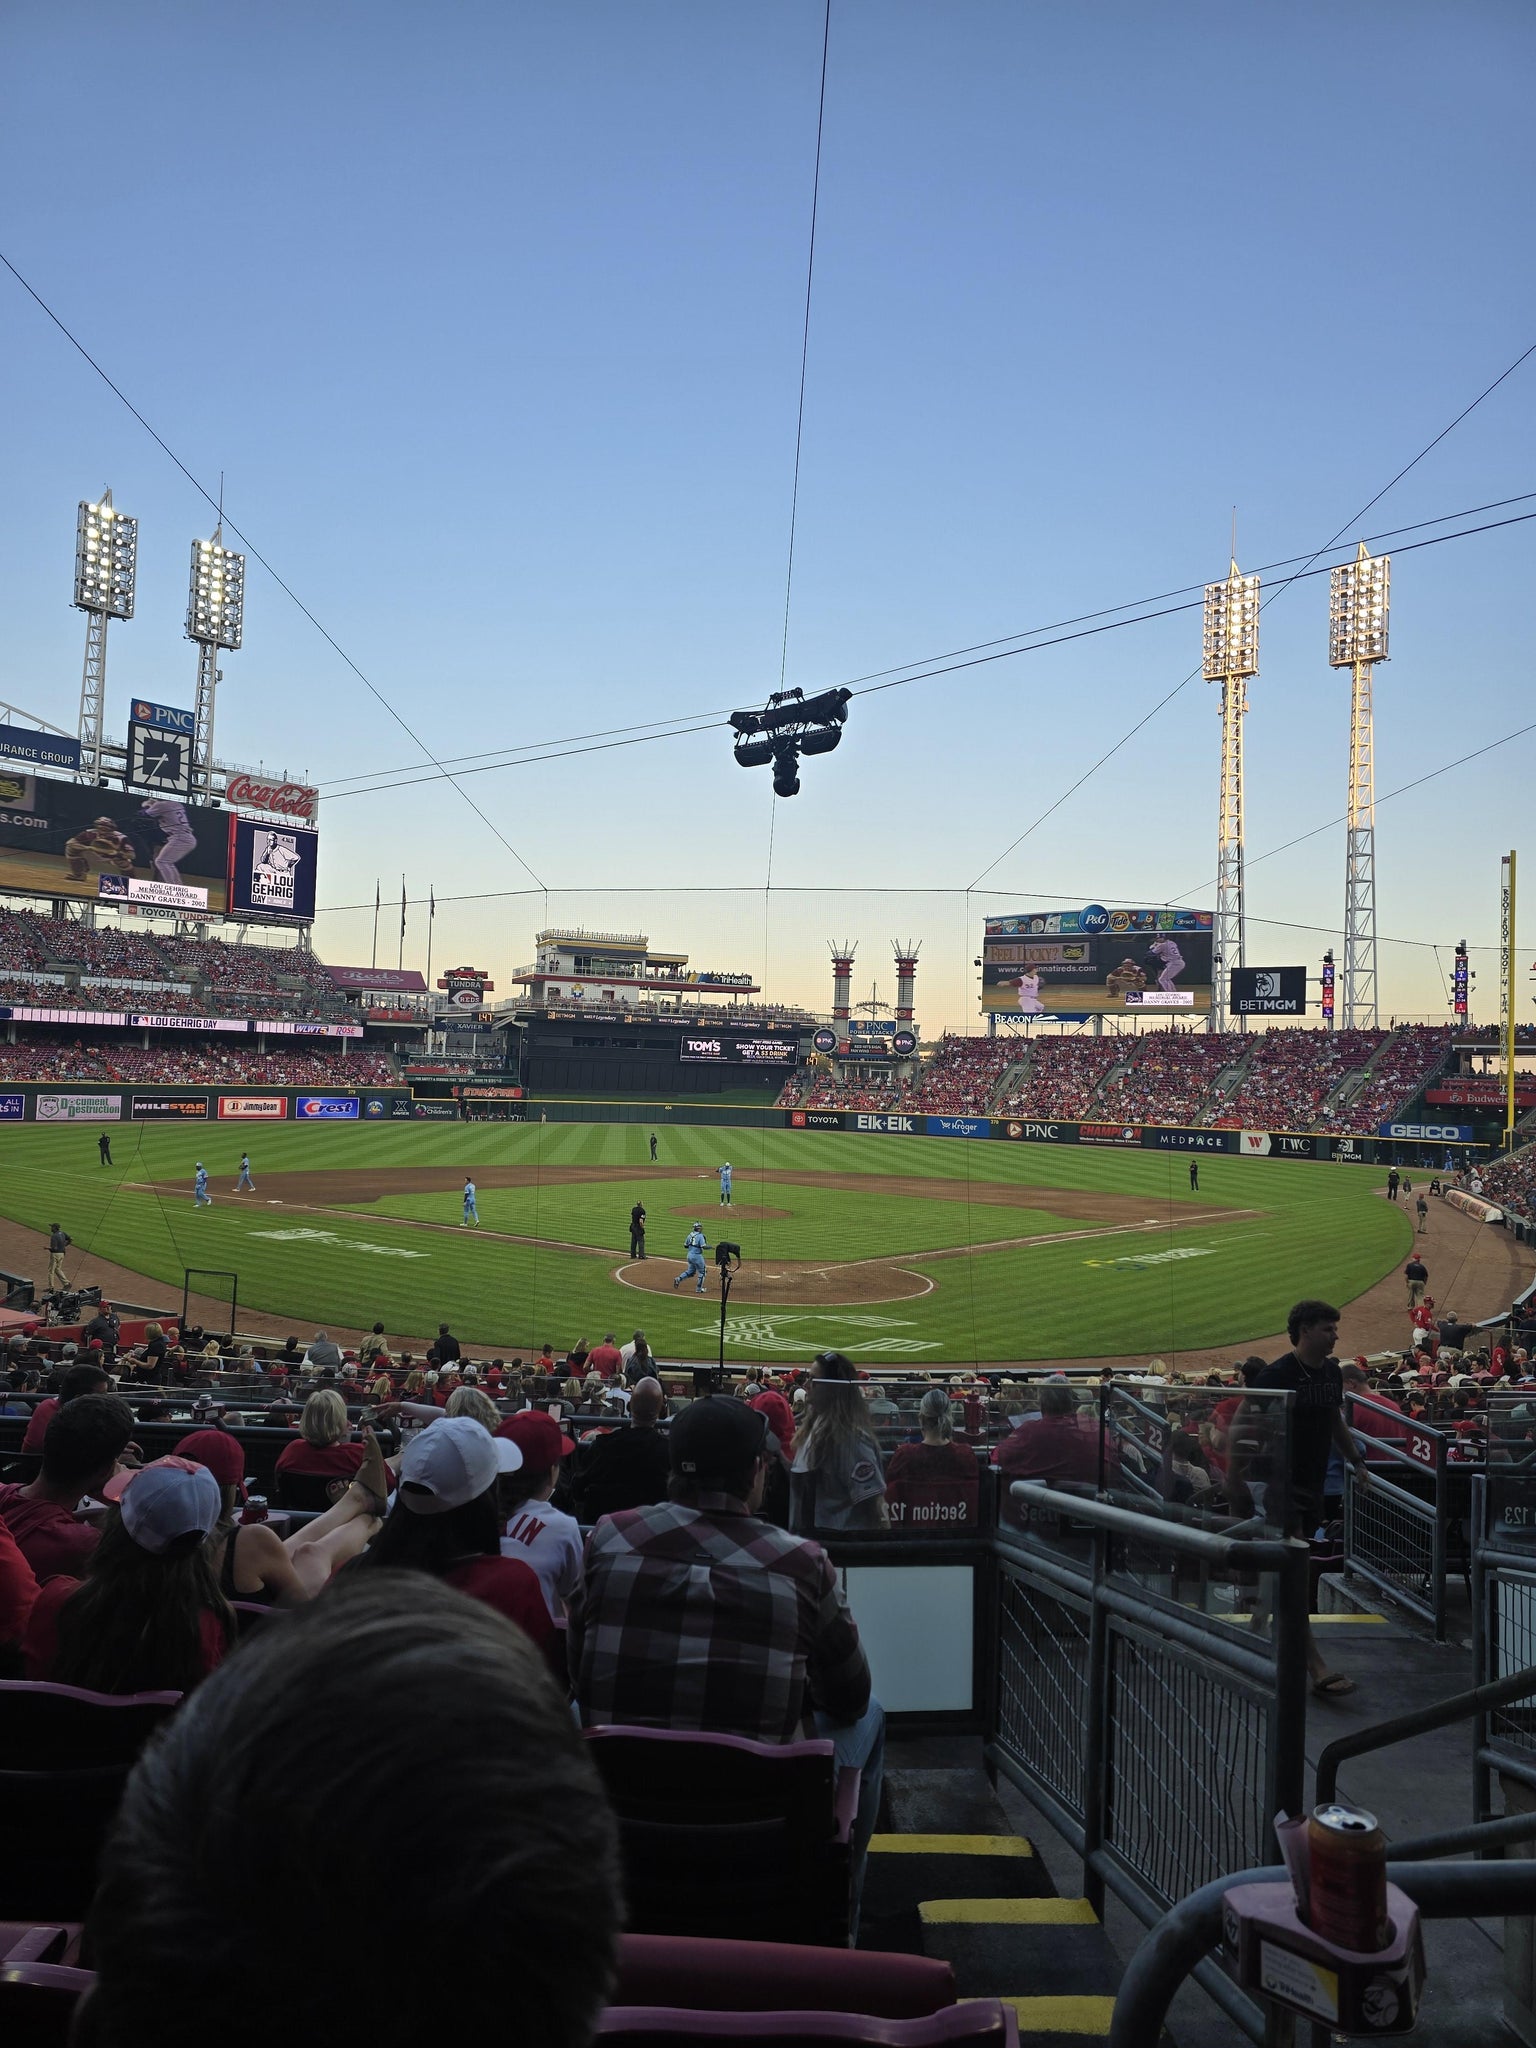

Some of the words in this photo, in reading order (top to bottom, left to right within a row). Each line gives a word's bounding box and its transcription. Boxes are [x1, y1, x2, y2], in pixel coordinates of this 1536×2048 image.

[154, 706, 194, 730] PNC
[40, 750, 74, 765] GROUP
[226, 775, 319, 817] Coca-Cola
[273, 875, 294, 887] LOU
[138, 886, 174, 896] MEMORIAL
[175, 891, 198, 899] AWARD
[164, 885, 189, 893] GEHRIG
[252, 883, 294, 899] GEHRIG
[130, 892, 157, 902] DANNY
[157, 895, 186, 905] GRAVES
[252, 895, 266, 904] DAY
[141, 907, 177, 919] TOYOTA
[178, 911, 215, 923] TUNDRA
[1085, 914, 1107, 925] P&G
[1111, 916, 1129, 928] Tide
[1016, 946, 1058, 962] LUCKY?
[1501, 947, 1509, 974] ROOT
[342, 970, 404, 984] Reds
[720, 975, 752, 985] TriHealth
[450, 981, 481, 989] TUNDRA
[1239, 1000, 1297, 1011] BETMGM
[151, 1017, 168, 1026] LOU
[170, 1018, 202, 1028] GEHRIG
[203, 1020, 217, 1029] DAY
[994, 1014, 1032, 1024] BEACON
[336, 1026, 356, 1036] ROSE
[866, 1022, 889, 1030] PNC
[687, 1040, 721, 1052] TOM'S
[305, 1101, 353, 1114] Crest
[808, 1116, 839, 1124] TOYOTA
[952, 1119, 977, 1134] Kroger
[1024, 1124, 1059, 1139] PNC
[1390, 1124, 1459, 1139] GEICO
[1160, 1135, 1223, 1147] MEDPACE
[1279, 1138, 1311, 1151] TWC
[1148, 1425, 1163, 1451] 22
[1412, 1435, 1431, 1461] 23
